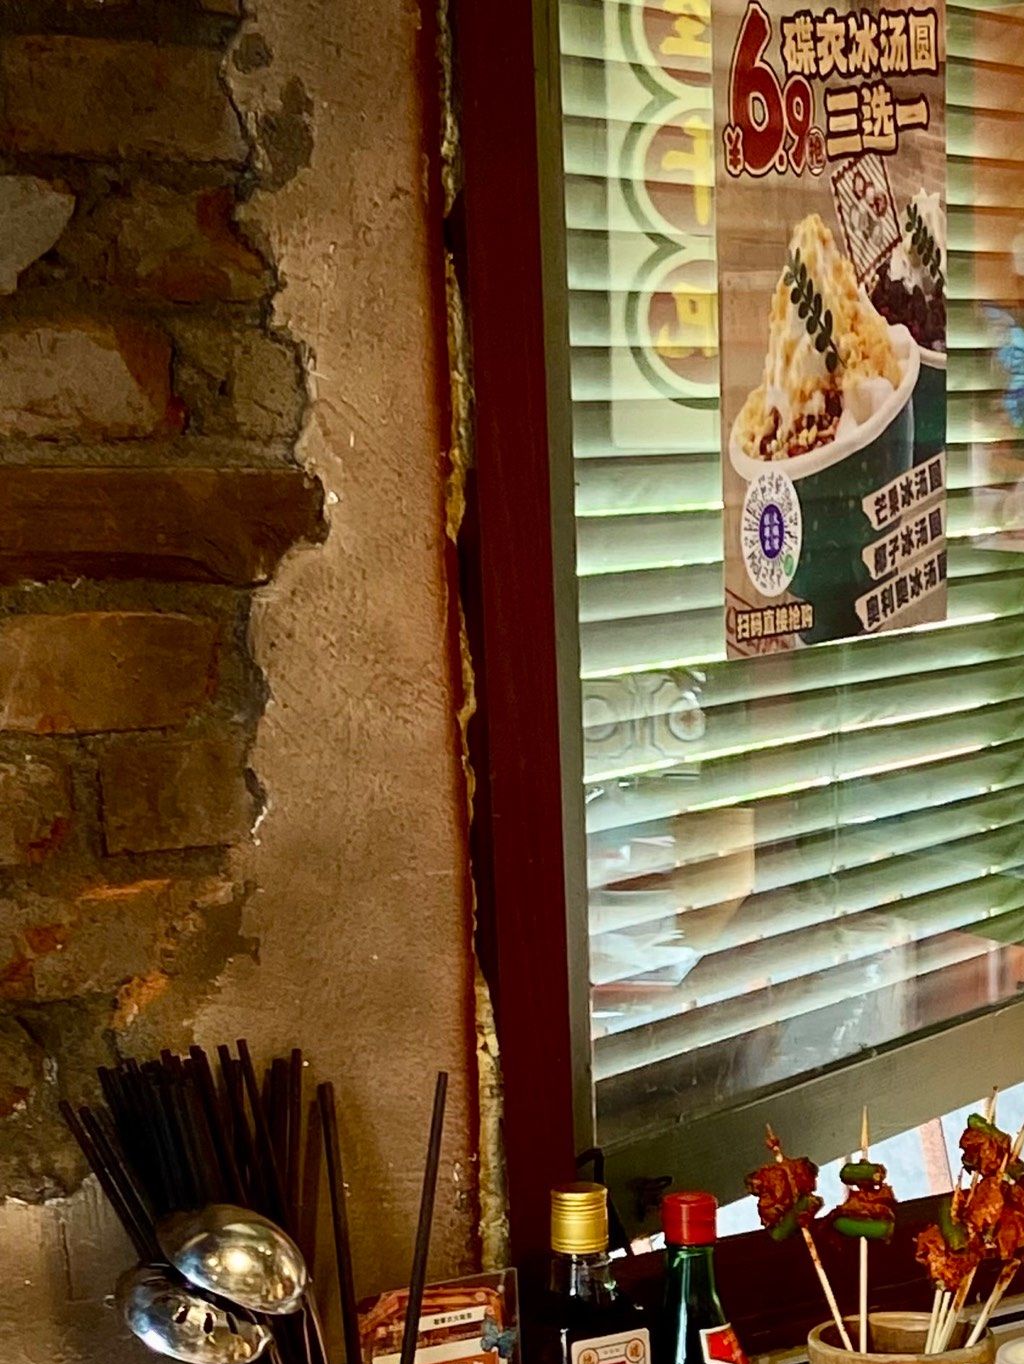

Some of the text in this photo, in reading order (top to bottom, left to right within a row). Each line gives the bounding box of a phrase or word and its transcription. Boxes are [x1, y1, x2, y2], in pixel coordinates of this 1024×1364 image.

[783, 9, 937, 79] 碟衣冰汤圆
[826, 81, 929, 160] 三选一
